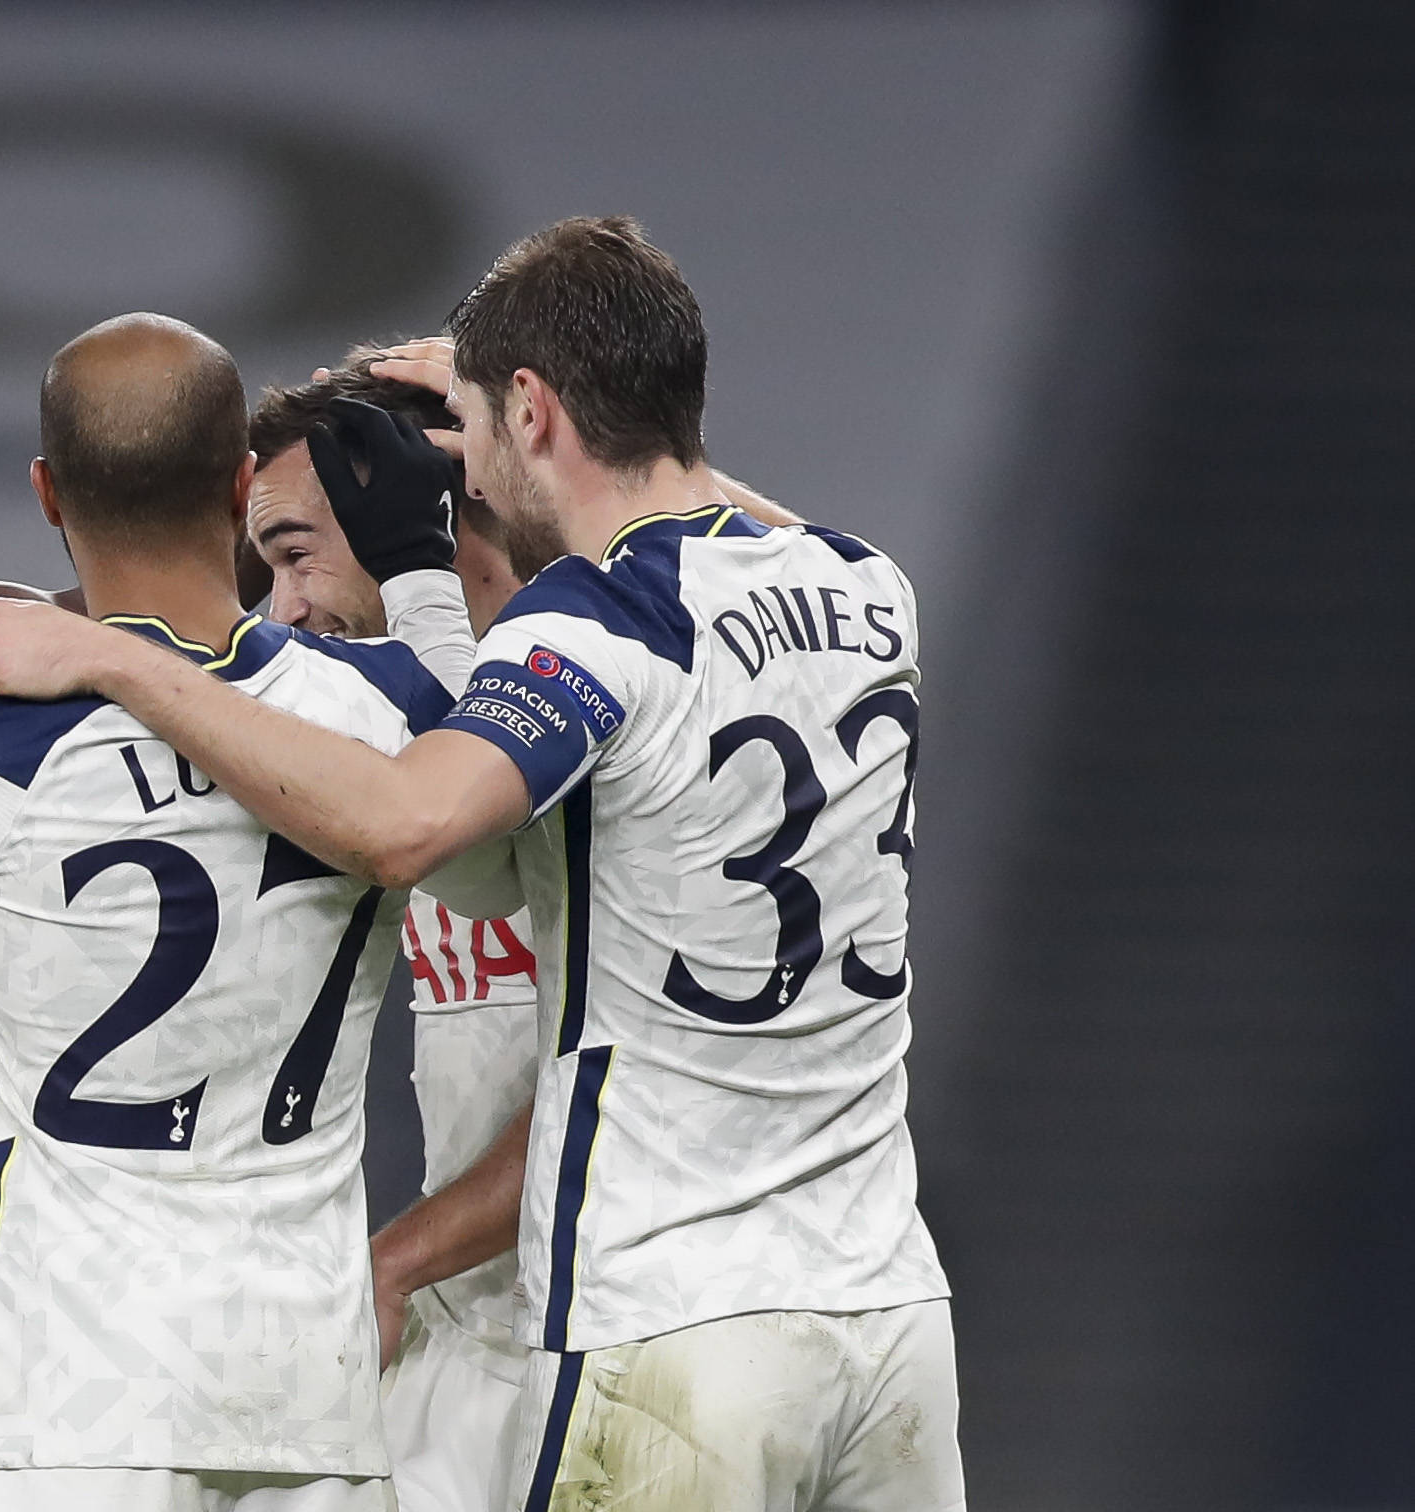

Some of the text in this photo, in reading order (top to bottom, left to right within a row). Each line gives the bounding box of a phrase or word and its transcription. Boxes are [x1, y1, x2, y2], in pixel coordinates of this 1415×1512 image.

[712, 586, 902, 681] DAVIES
[466, 700, 542, 742] RESPECT
[479, 677, 502, 692] TO
[502, 681, 568, 733] RACISM
[559, 667, 619, 736] RESPECT
[661, 688, 919, 1025] 33
[32, 832, 387, 1152] 27
